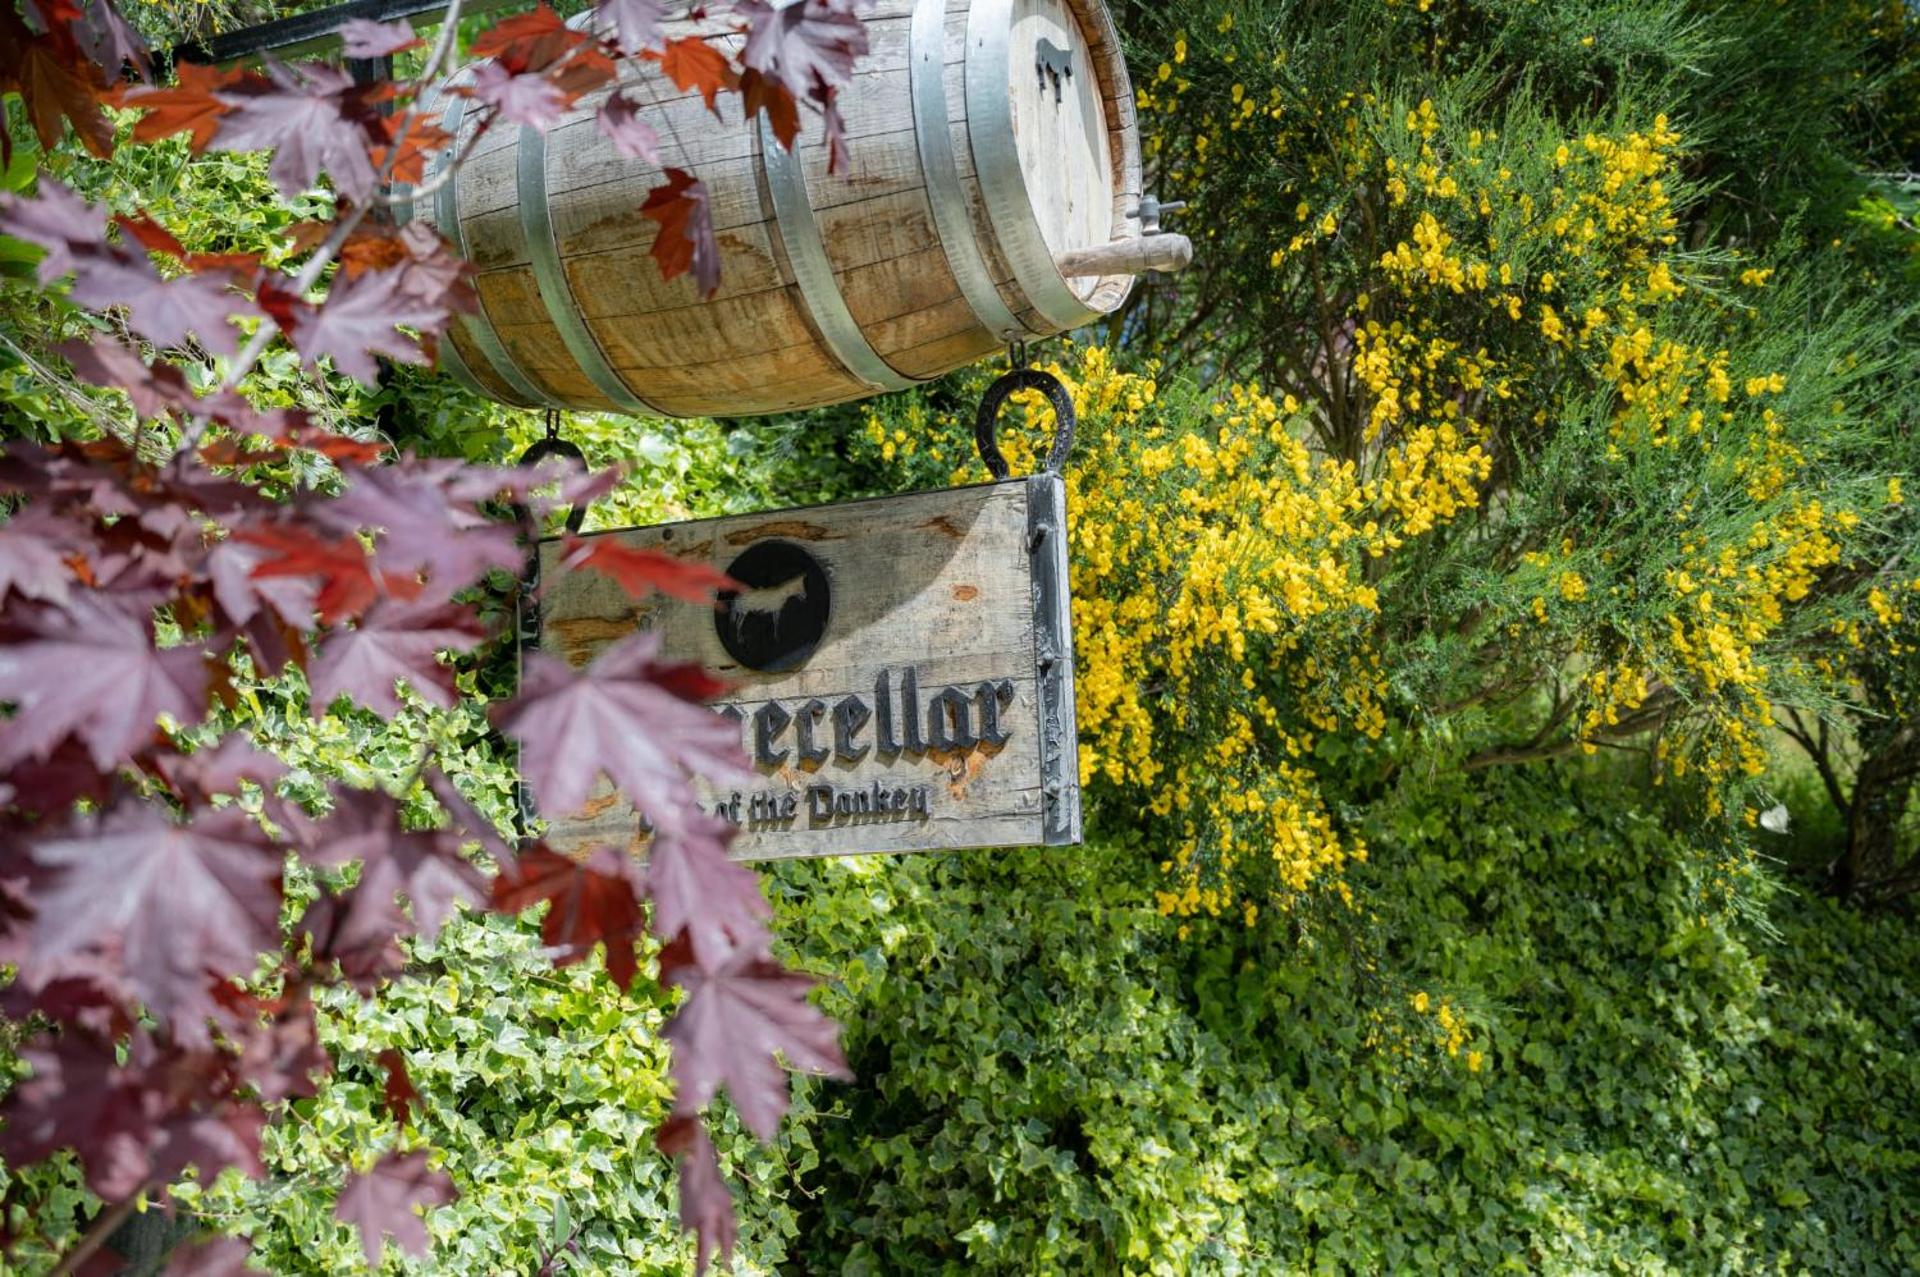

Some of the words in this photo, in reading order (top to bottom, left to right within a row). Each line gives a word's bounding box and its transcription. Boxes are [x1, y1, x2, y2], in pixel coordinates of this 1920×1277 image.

[706, 666, 1015, 764] ecellar
[749, 787, 798, 822] the
[806, 779, 931, 822] Donkey
